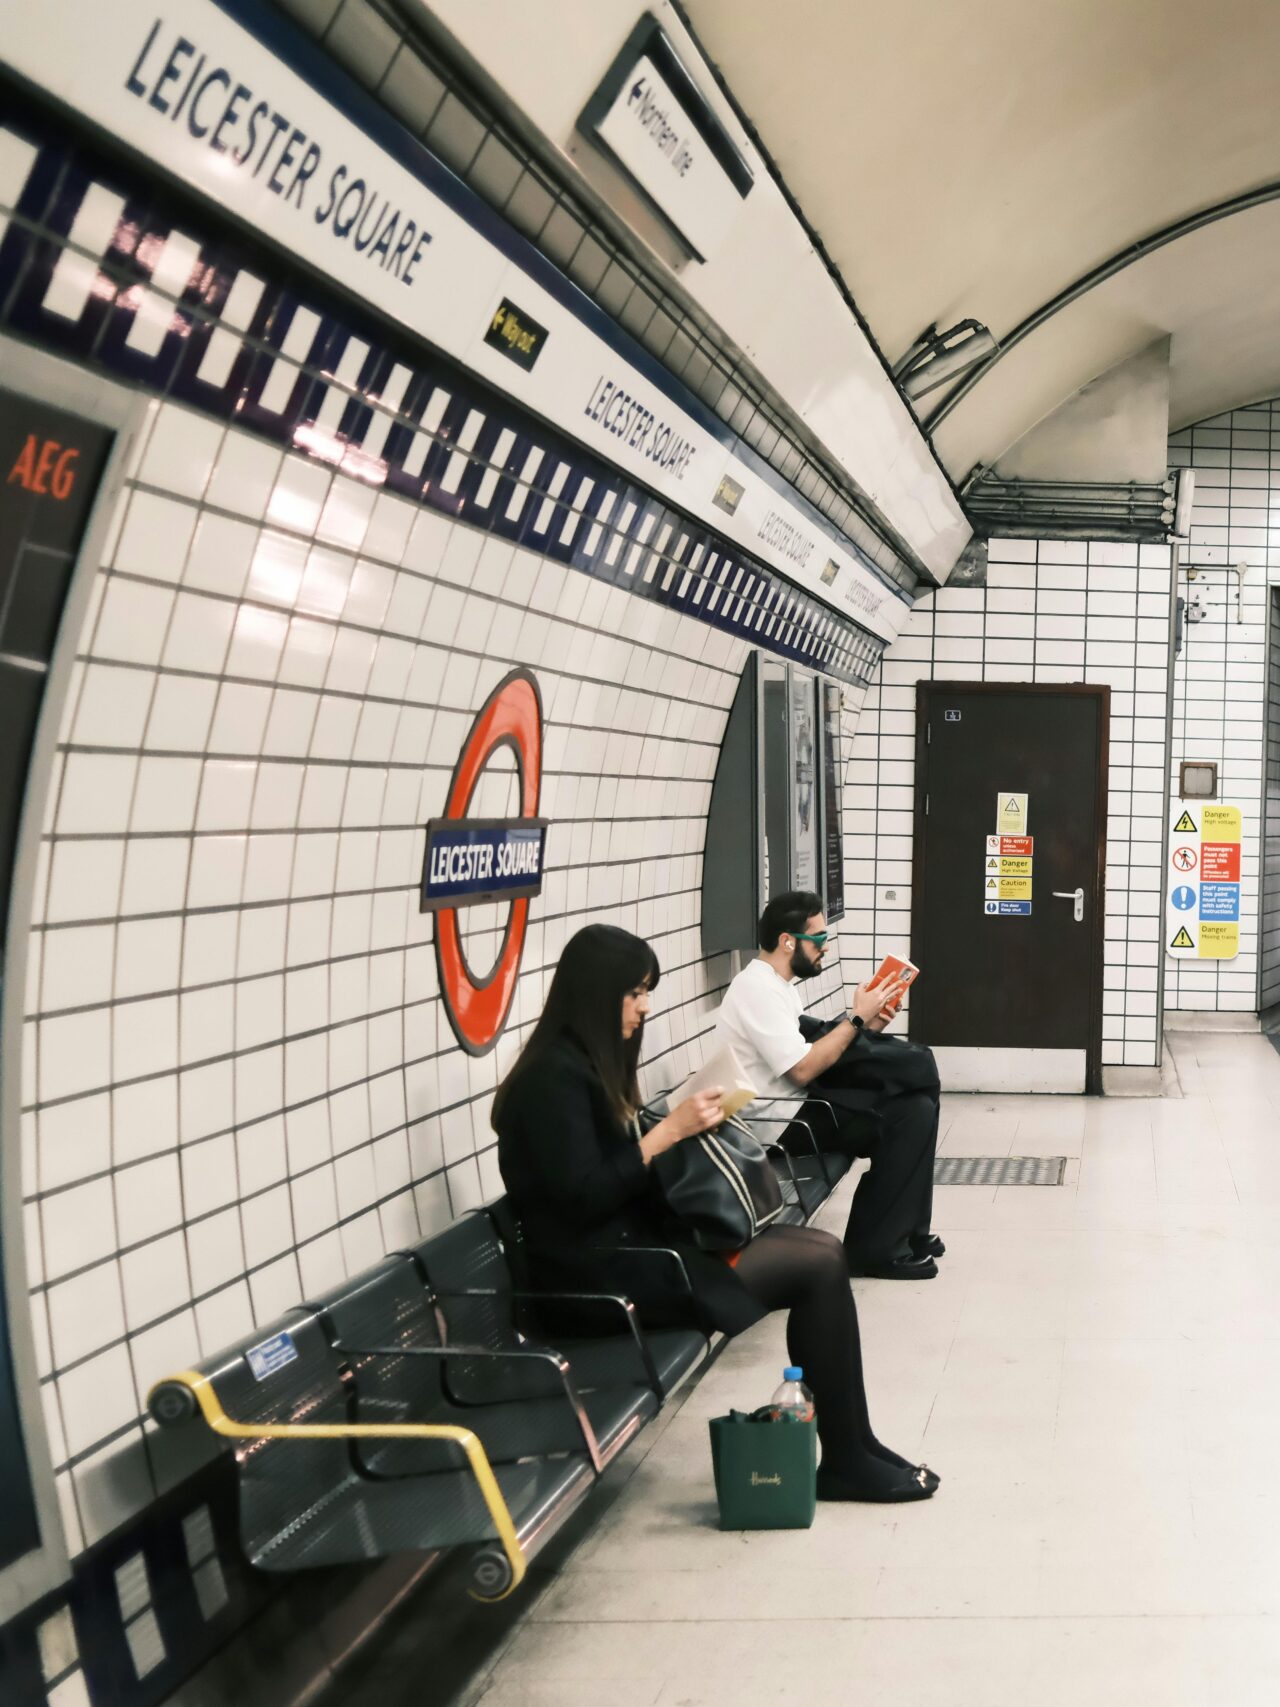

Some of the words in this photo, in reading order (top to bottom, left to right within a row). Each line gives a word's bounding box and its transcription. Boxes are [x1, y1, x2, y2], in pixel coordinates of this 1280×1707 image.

[633, 86, 679, 160] Northern
[671, 138, 693, 178] line
[124, 18, 322, 210] LEICESTER
[314, 164, 433, 286] SQUARE
[501, 312, 522, 348] Way
[584, 375, 655, 452] LEICESTER
[645, 422, 696, 480] SQUARE
[7, 434, 81, 500] AEG
[1204, 811, 1229, 819] Danger
[430, 844, 494, 884] LEICESTER
[495, 841, 540, 878] SQUARE
[1001, 859, 1028, 867] Danger
[1201, 925, 1227, 933] Danger
[750, 1471, 782, 1486] Harrods
